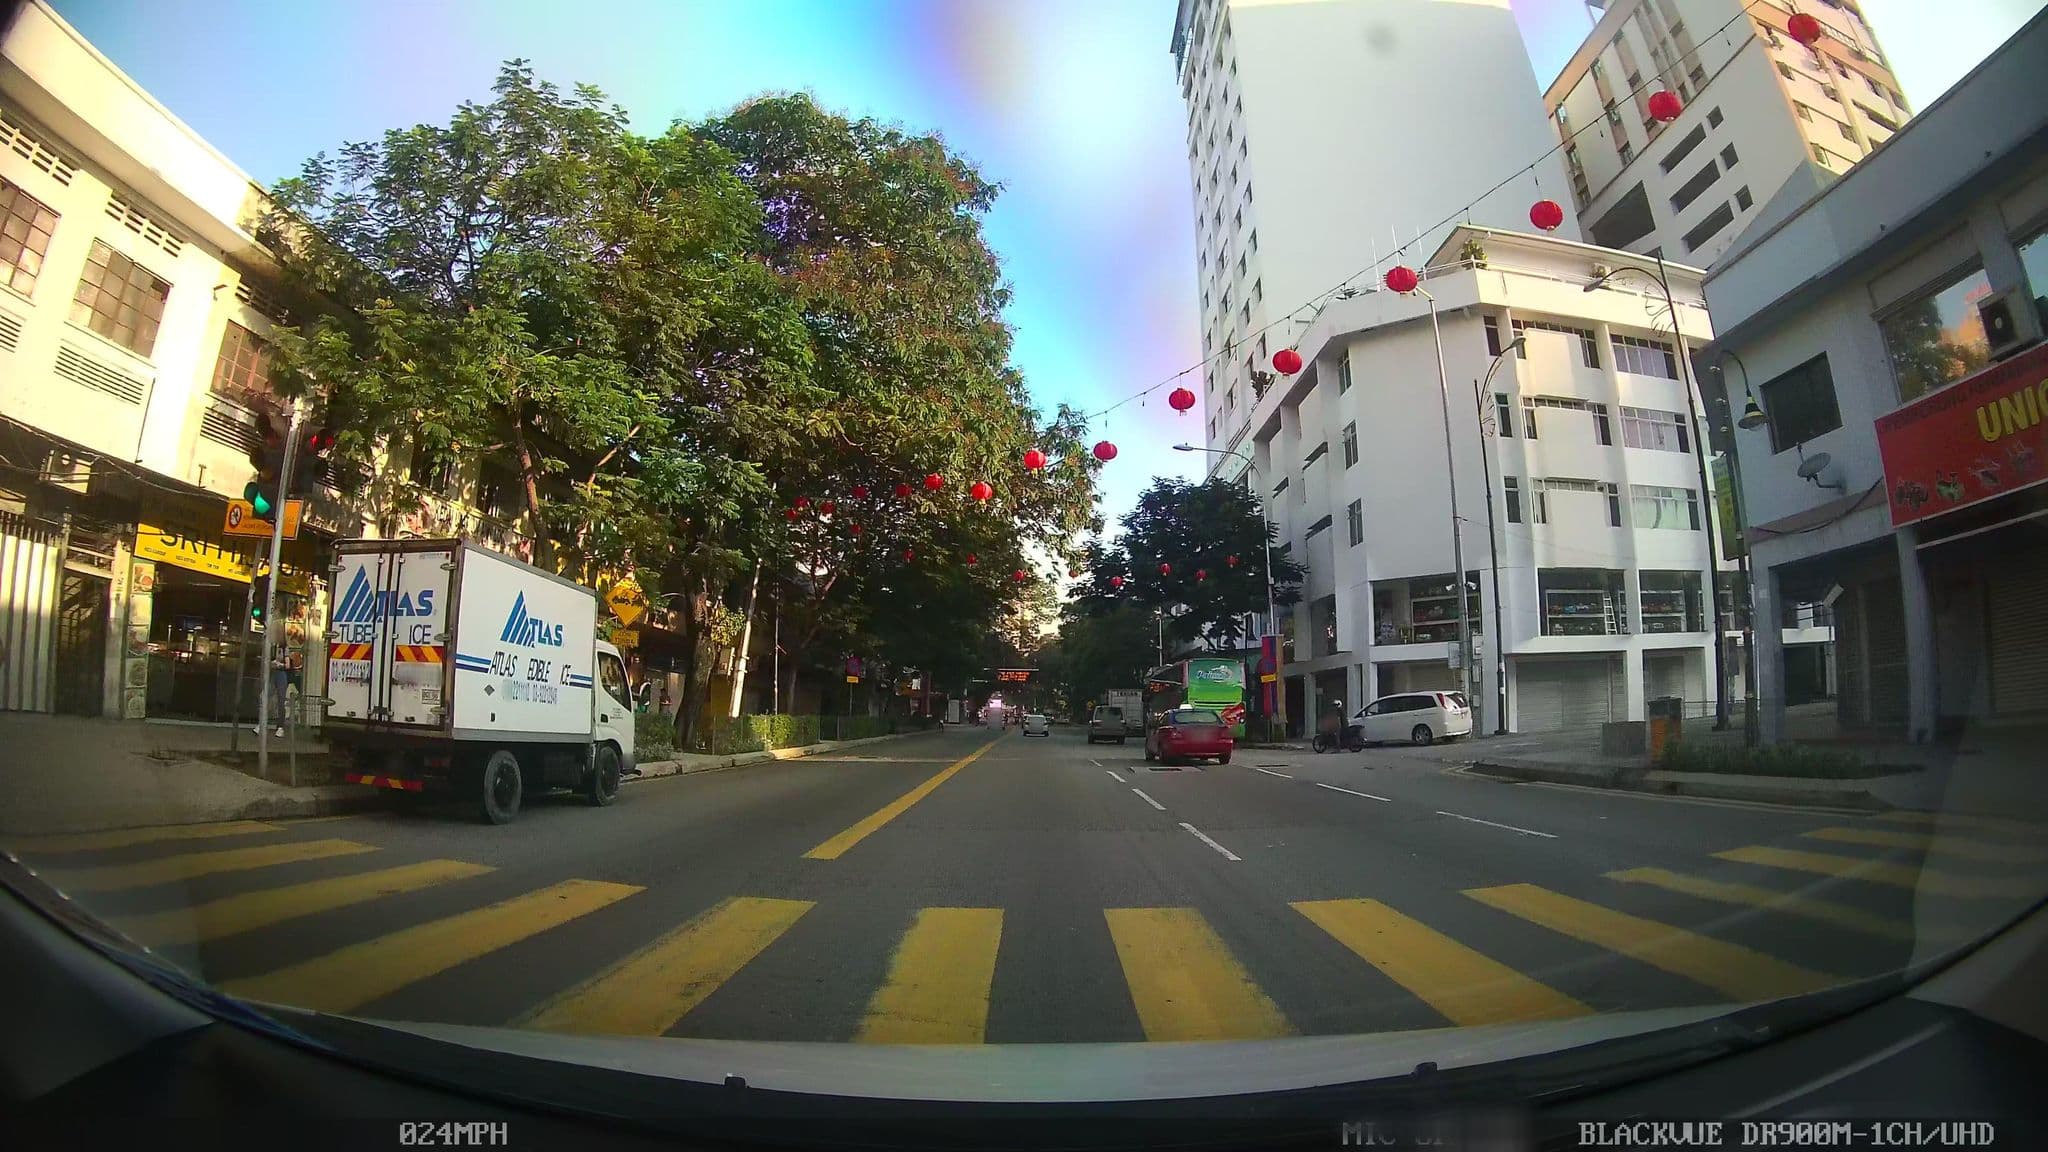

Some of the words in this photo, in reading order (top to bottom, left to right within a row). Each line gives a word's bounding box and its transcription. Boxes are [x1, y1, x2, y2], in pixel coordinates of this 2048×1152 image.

[333, 564, 434, 623] ATLAS
[339, 624, 373, 644] TUBE
[408, 624, 432, 645] ICE
[500, 590, 564, 648] ATLAS
[490, 651, 518, 677] ATLAS
[560, 664, 572, 686] ICE
